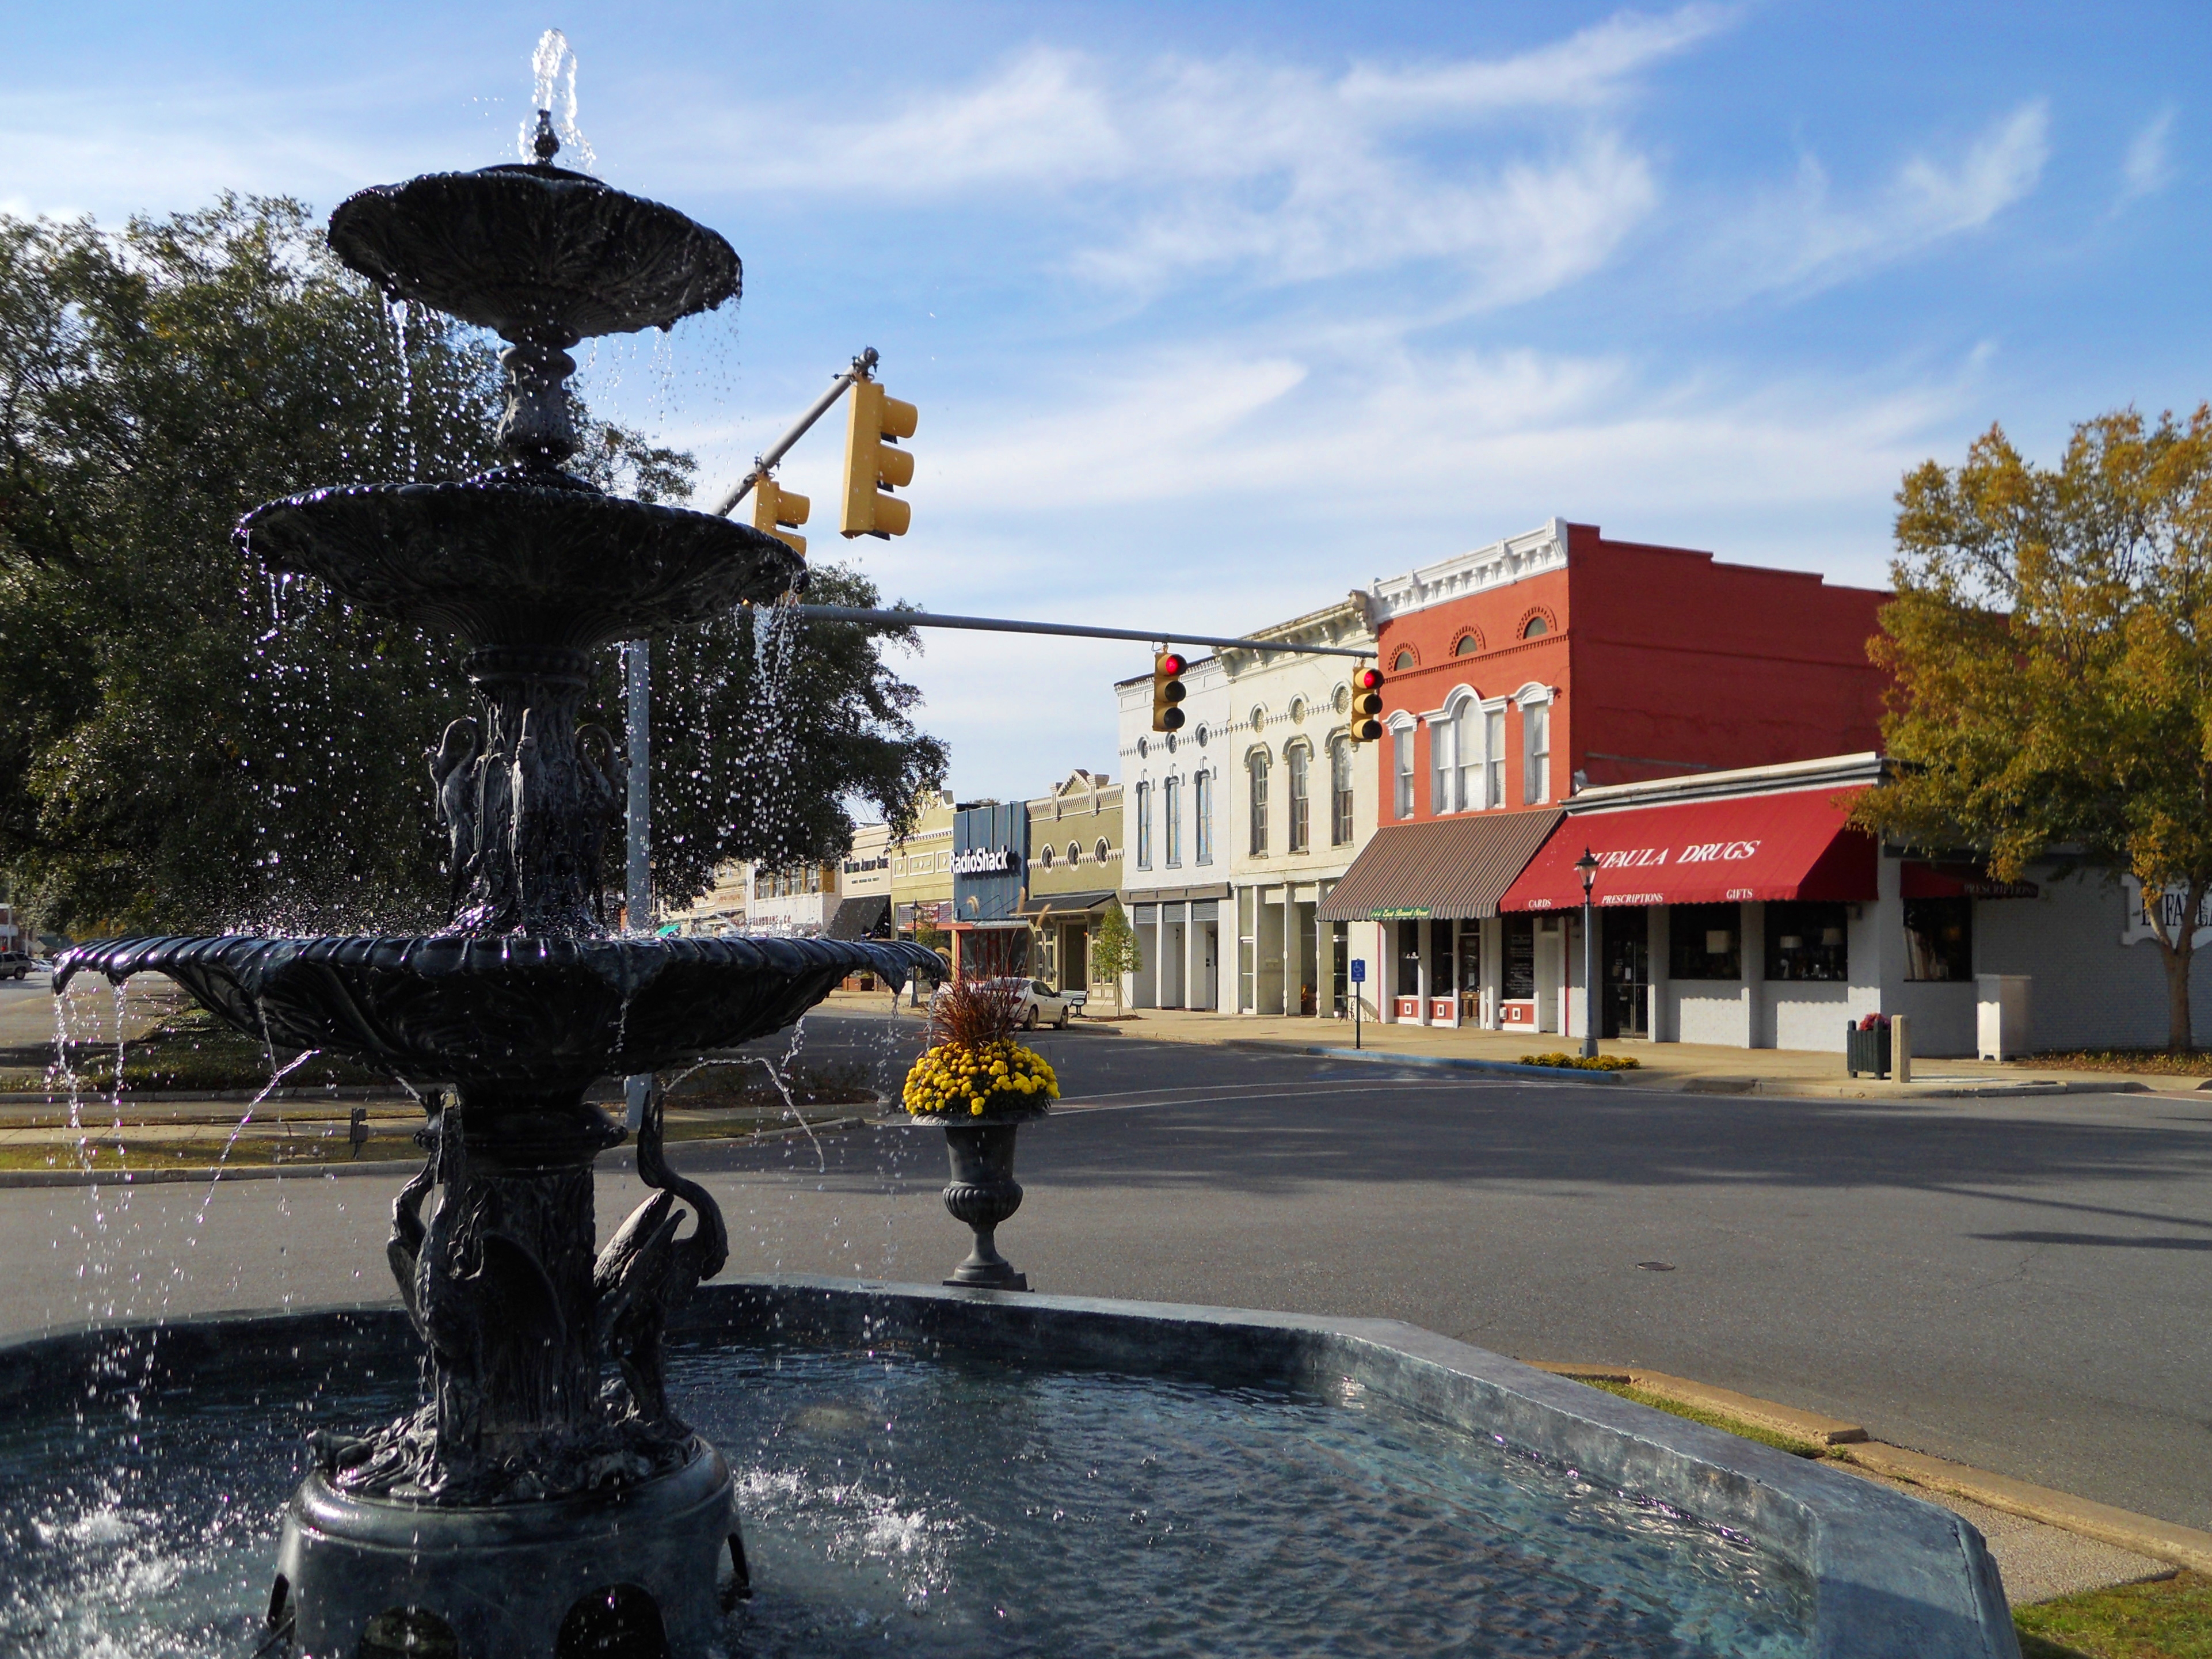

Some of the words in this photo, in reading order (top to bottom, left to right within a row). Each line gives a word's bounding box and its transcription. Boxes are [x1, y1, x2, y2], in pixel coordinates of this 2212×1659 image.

[949, 844, 1008, 874] RadioShack
[1675, 840, 1761, 863] DRUGS
[1528, 899, 1552, 908] CARDS
[1601, 893, 1664, 904] PRESCRIPTIONS
[1726, 888, 1753, 899] GIFTS
[1383, 909, 1395, 917] East
[1414, 908, 1429, 916] Street
